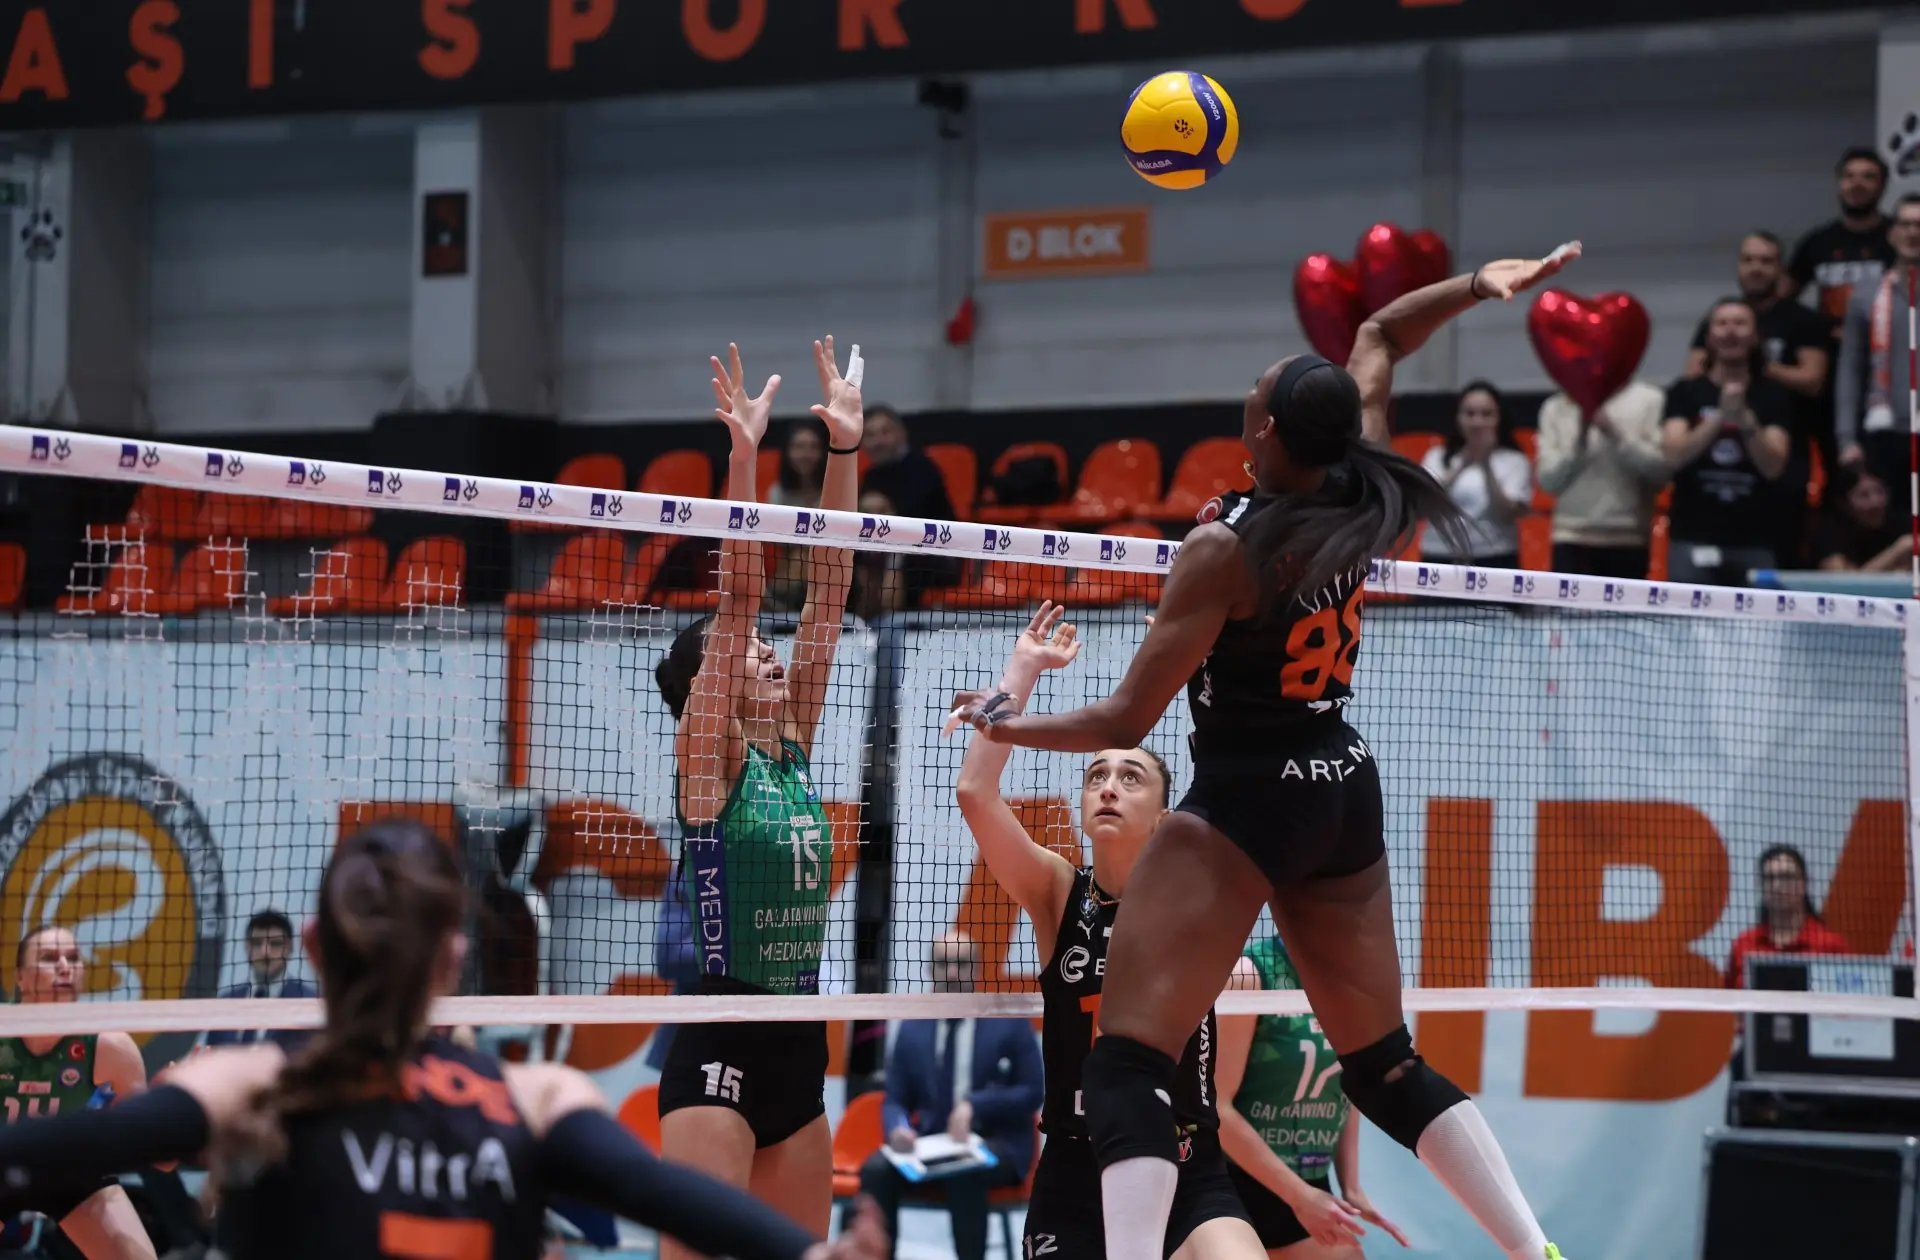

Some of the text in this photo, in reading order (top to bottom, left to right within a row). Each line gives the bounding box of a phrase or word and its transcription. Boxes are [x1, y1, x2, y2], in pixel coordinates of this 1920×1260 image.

[1203, 92, 1220, 121] V200W
[1006, 223, 1124, 263] D BLOK
[790, 829, 821, 891] 15
[701, 1061, 744, 1103] 15
[1023, 1232, 1058, 1260] 12
